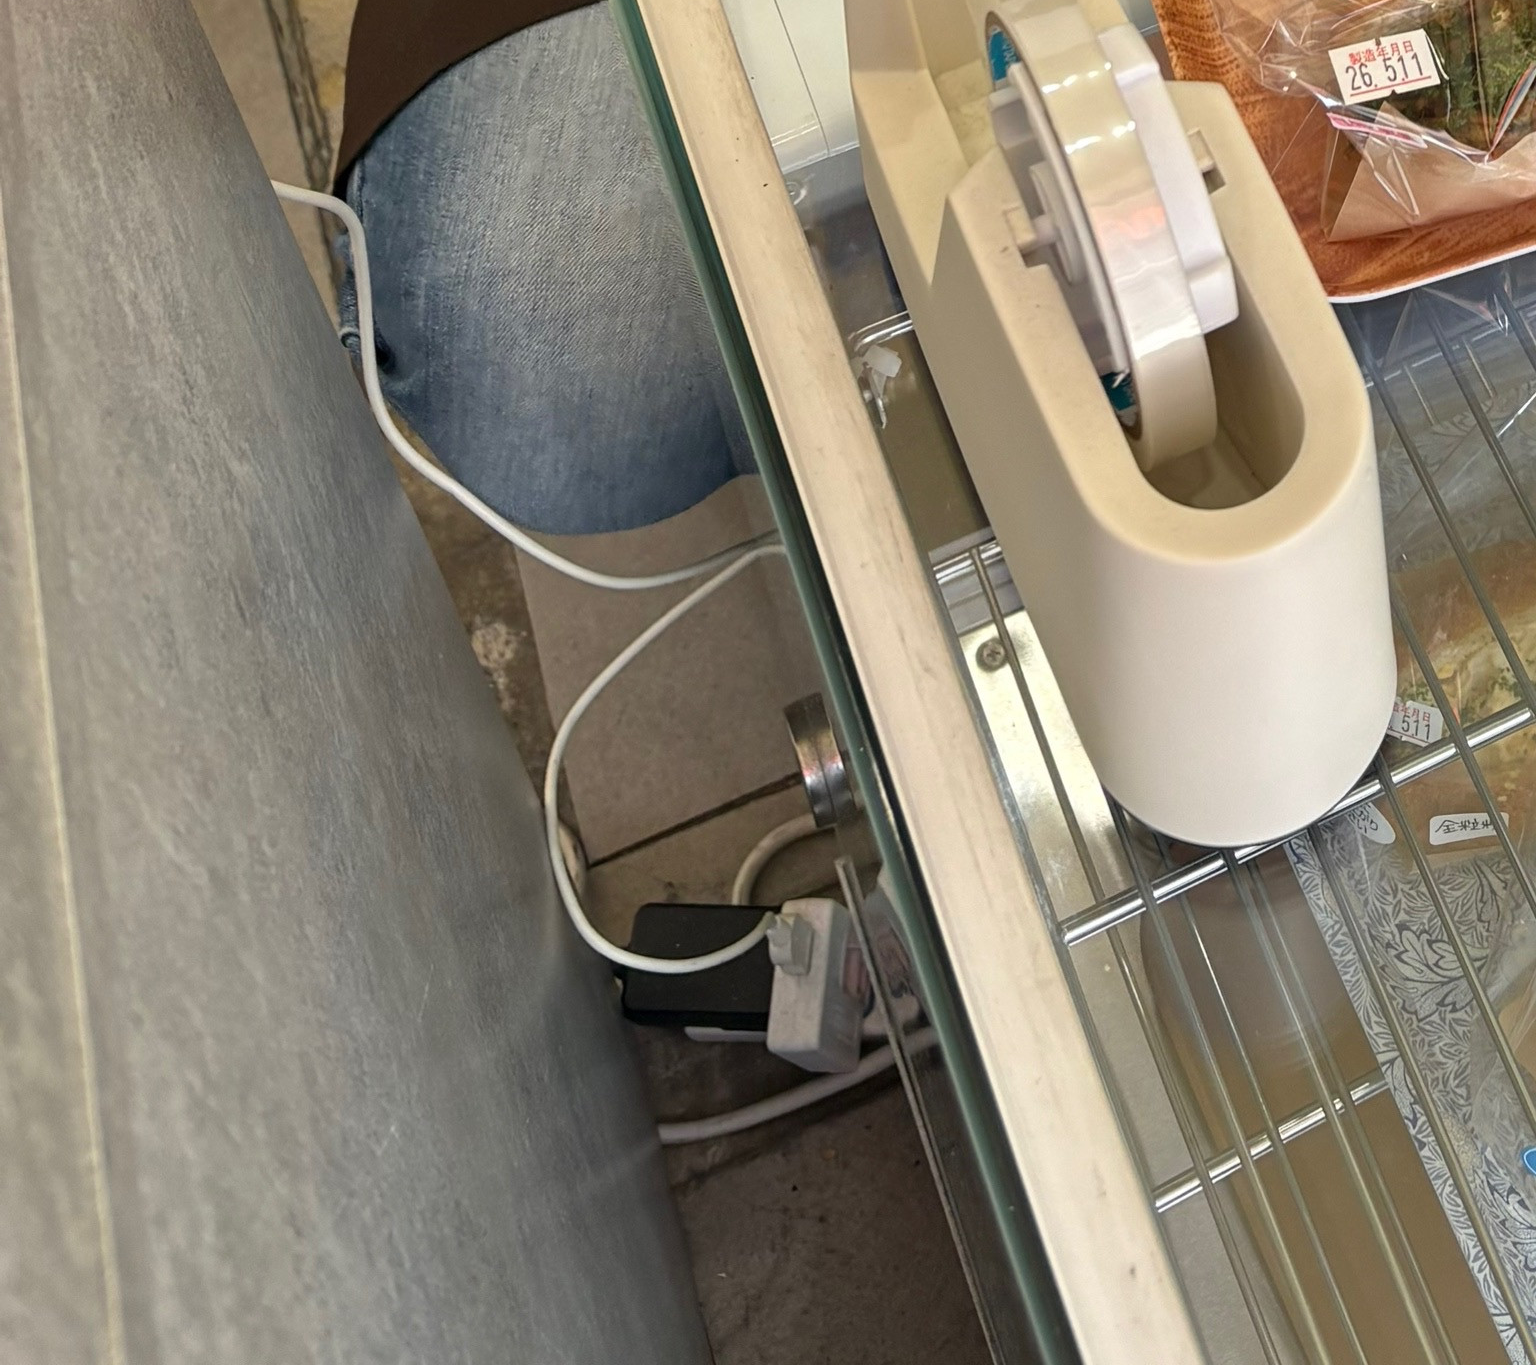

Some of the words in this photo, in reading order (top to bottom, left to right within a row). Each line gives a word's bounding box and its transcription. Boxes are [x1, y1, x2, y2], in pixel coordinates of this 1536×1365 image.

[1348, 40, 1415, 66] 製造年月日
